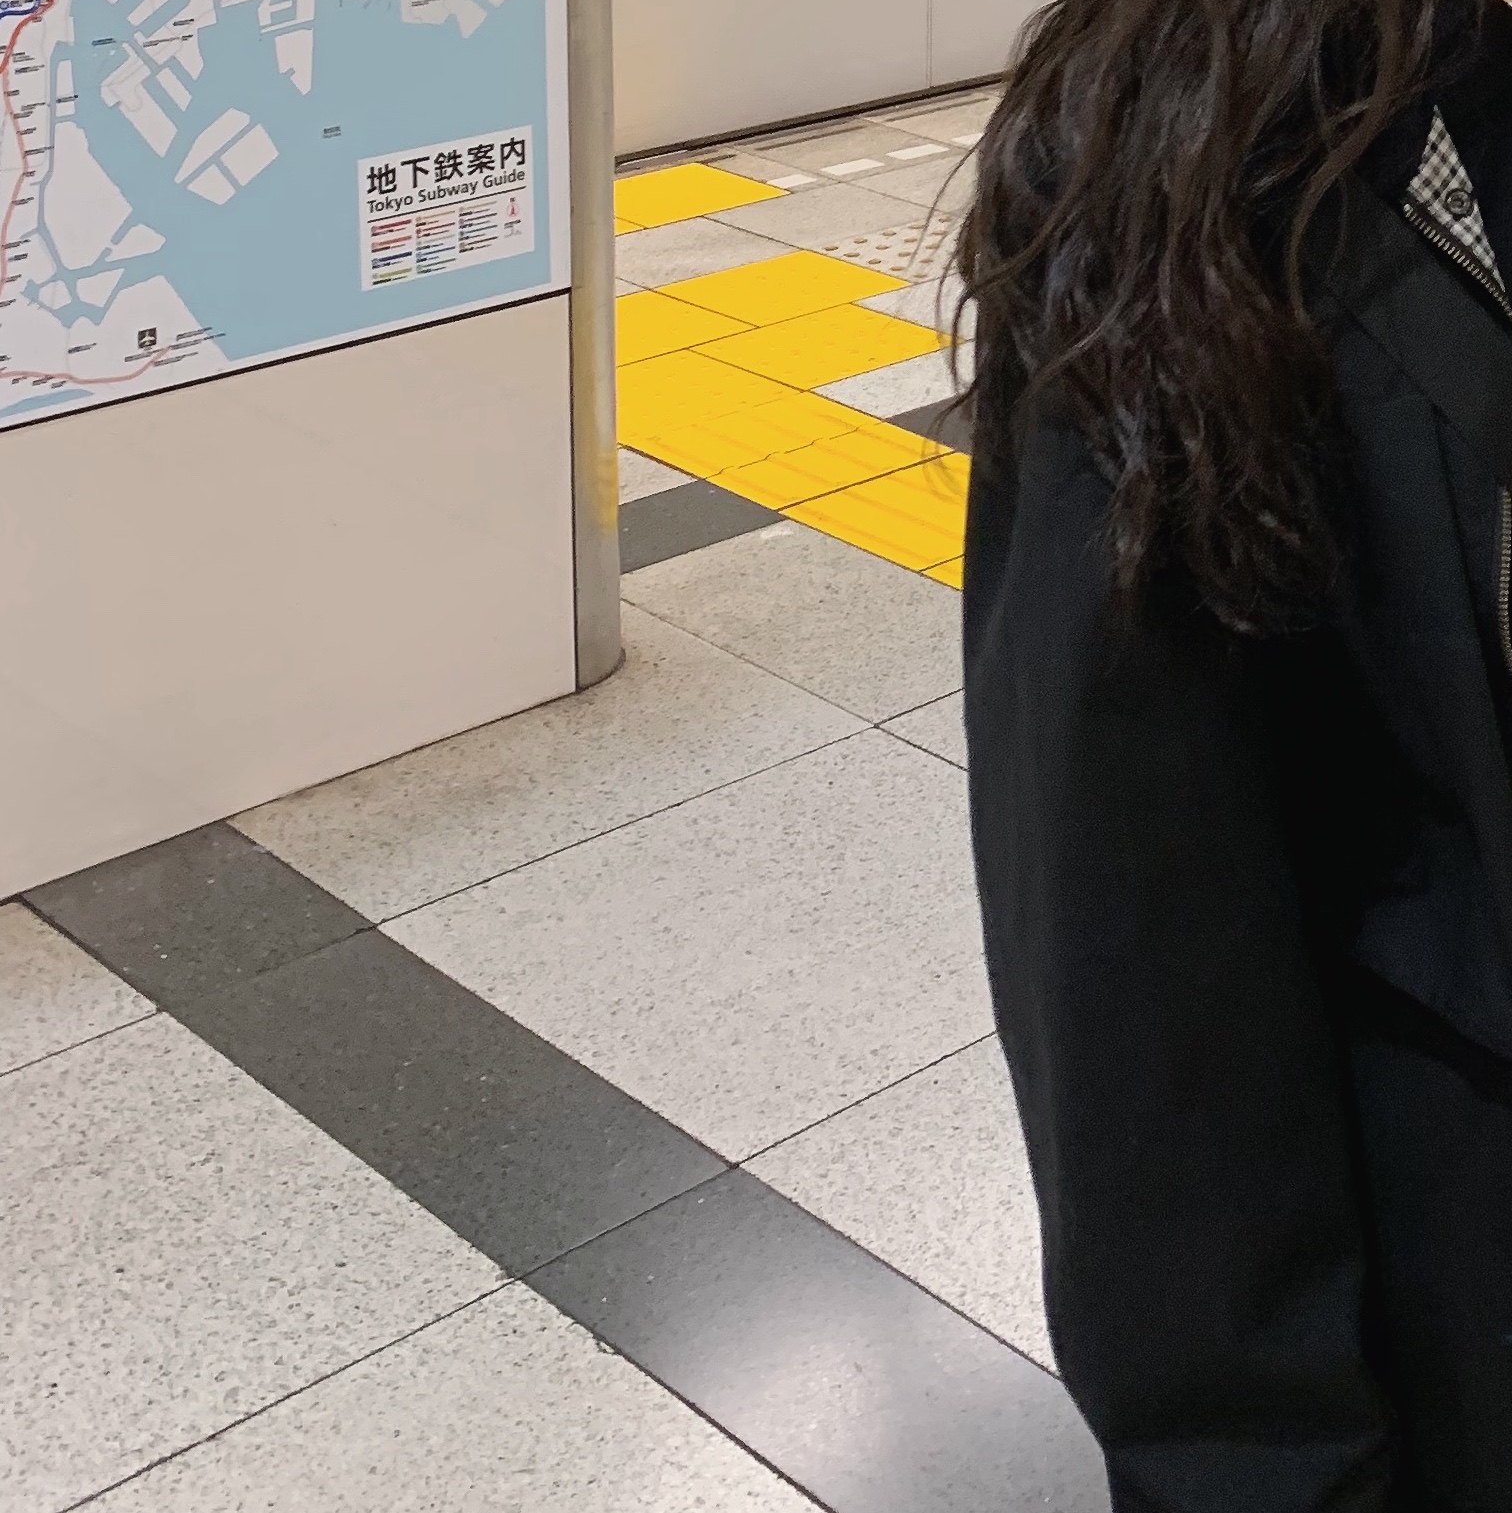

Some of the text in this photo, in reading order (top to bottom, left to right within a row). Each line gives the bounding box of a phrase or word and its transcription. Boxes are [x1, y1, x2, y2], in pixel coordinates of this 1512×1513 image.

[367, 137, 526, 195] 地下鉄案内
[367, 169, 525, 213] Tokyo Subway Guide
